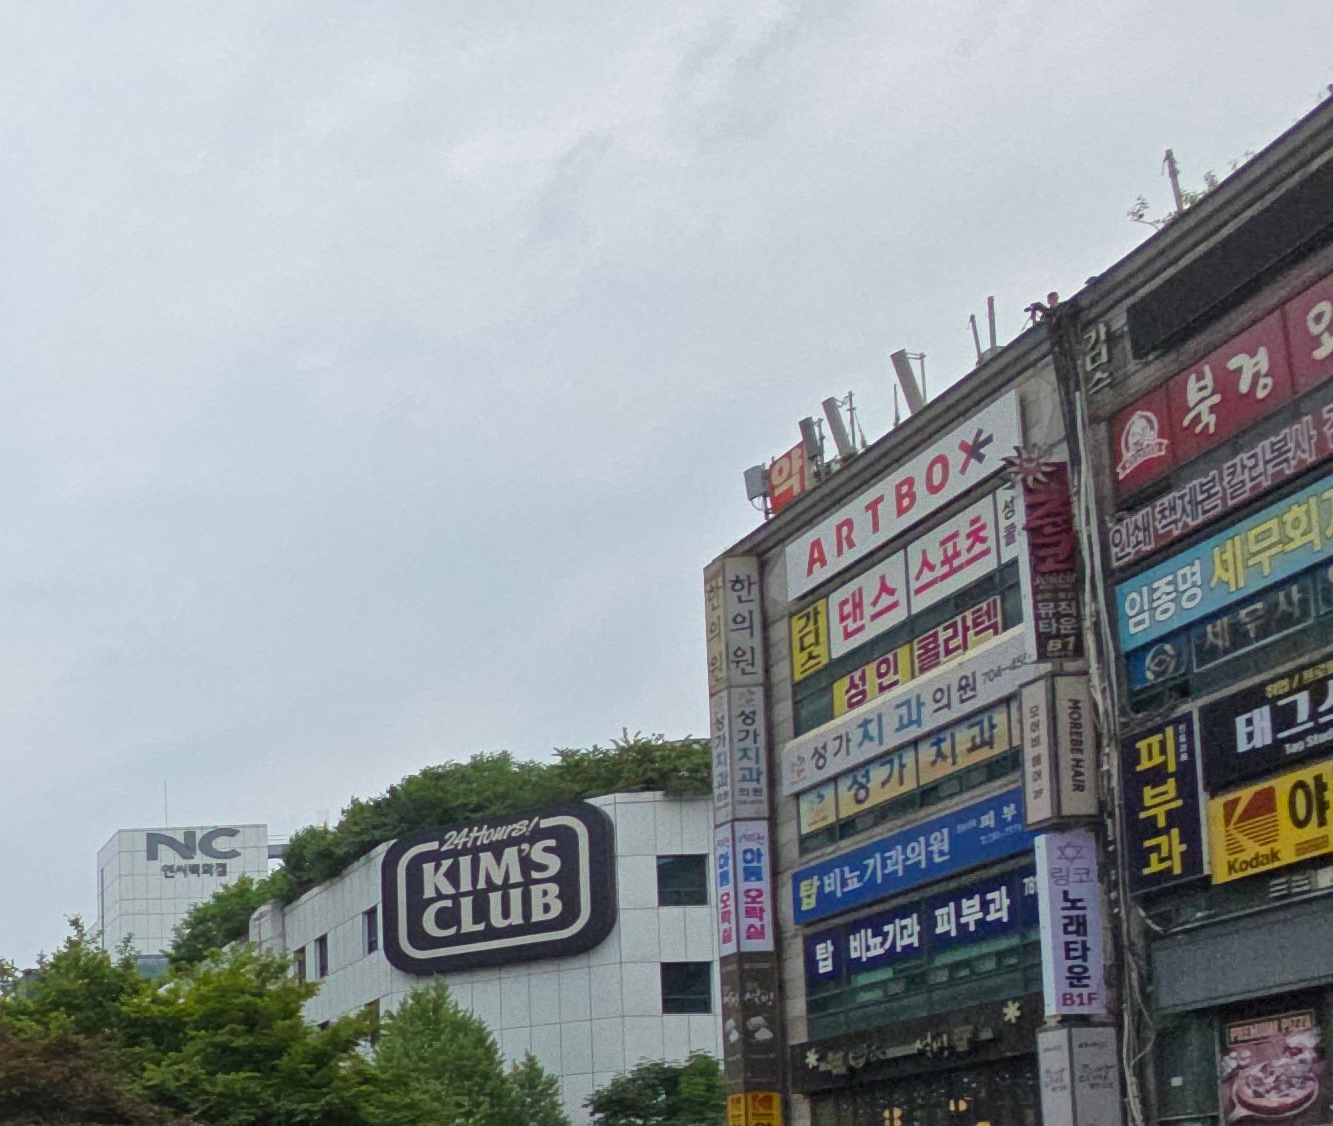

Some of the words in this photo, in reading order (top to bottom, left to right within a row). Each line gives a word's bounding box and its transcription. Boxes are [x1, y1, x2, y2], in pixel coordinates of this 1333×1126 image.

[806, 428, 994, 577] ARTBOX
[839, 573, 900, 640] 댄스
[913, 515, 991, 596] 스포츠
[1124, 559, 1202, 635] 임종명
[729, 574, 757, 676] 한의원
[845, 652, 900, 710] 성인
[917, 598, 1000, 674] 콜라텍
[146, 828, 242, 860] NC
[1135, 725, 1187, 876] 피부과
[422, 839, 561, 899] KIM'S
[1227, 846, 1281, 876] Kodak
[422, 882, 563, 937] CLUB
[816, 940, 834, 974] 탑
[849, 913, 921, 962] 비뇨기과
[935, 886, 1010, 937] 피부과
[1061, 890, 1091, 988] 노래타운
[1061, 992, 1099, 1007] B1F
